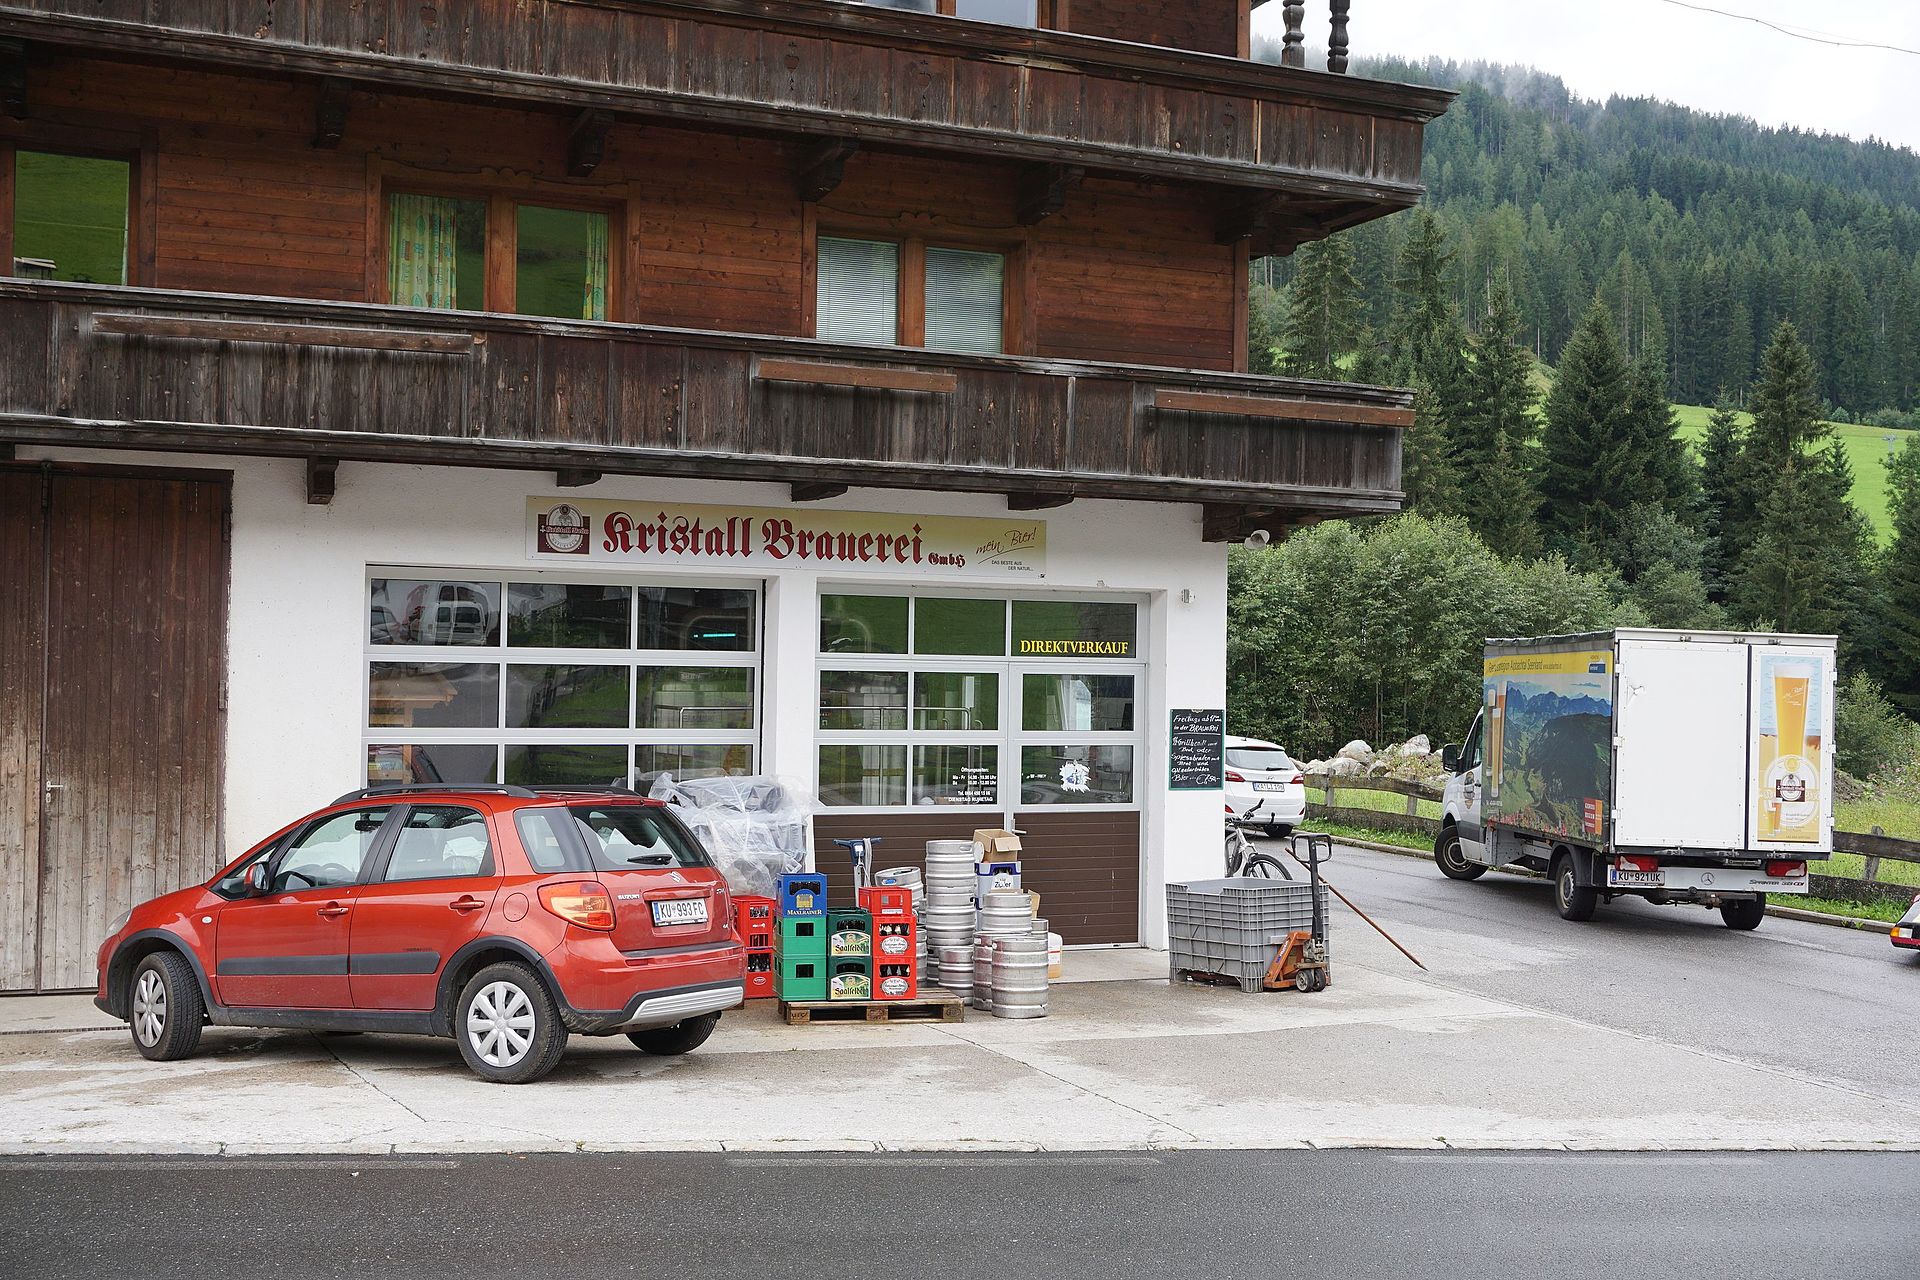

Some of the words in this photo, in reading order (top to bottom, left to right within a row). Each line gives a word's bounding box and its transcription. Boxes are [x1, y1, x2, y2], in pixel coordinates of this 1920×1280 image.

[603, 511, 754, 558] Kristall
[762, 518, 923, 564] Brauerei
[928, 552, 966, 568] GmbH
[976, 540, 1004, 555] mein
[1004, 527, 1037, 546] Bier!
[1020, 640, 1128, 654] DIREKTVERKAUF
[1618, 872, 1629, 880] KU
[660, 902, 671, 918] KU
